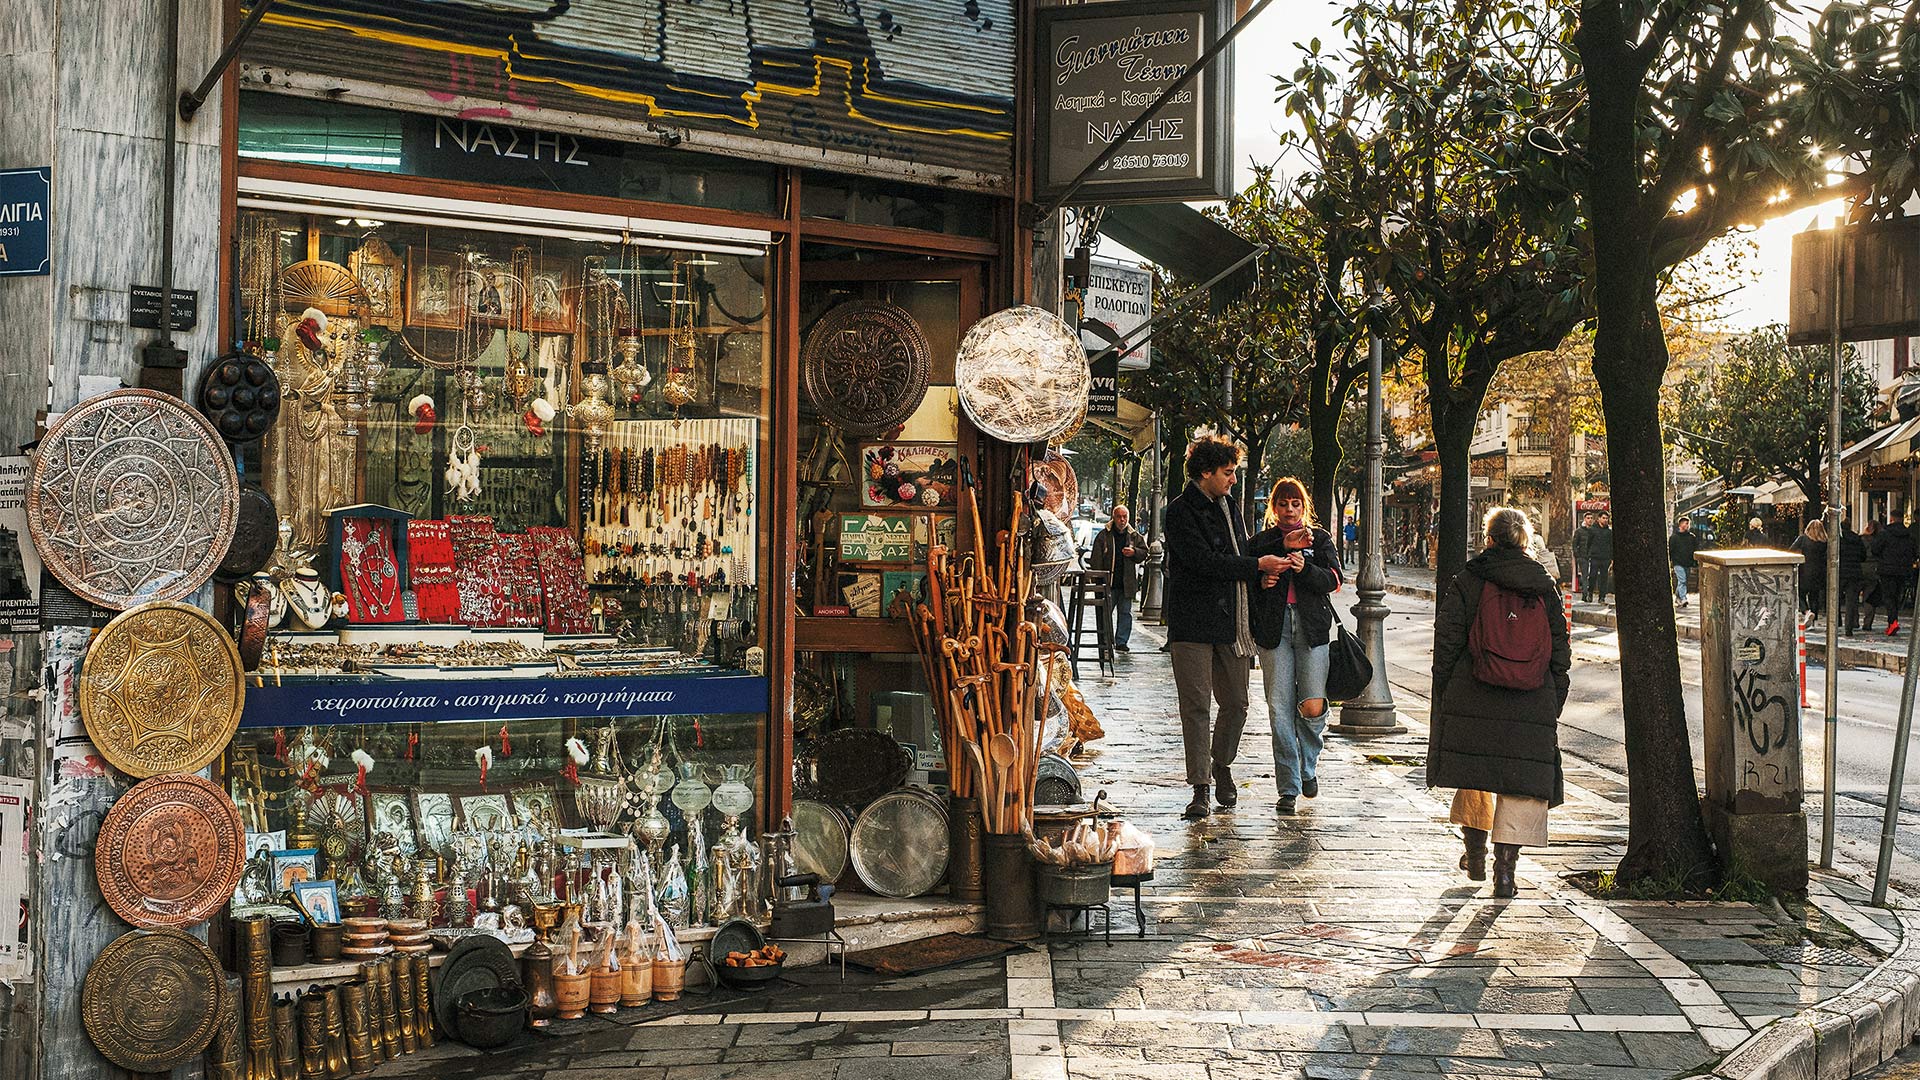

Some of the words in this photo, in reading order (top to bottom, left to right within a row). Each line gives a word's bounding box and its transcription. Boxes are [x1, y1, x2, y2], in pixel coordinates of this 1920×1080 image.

[1117, 54, 1188, 82] Τέχνη
[1055, 90, 1105, 112] Ασημικά
[435, 117, 589, 166] ΝΑΣΗΣ
[1087, 118, 1184, 145] ΝΑΣΗΣ
[1113, 156, 1150, 169] 26510
[1152, 153, 1189, 168] 73019
[1089, 275, 1144, 296] ΕΠΙΣΚΕΥΕΣ
[1094, 295, 1147, 316] ΡΟΛΟΓΙΩΝ
[1090, 377, 1115, 391] χνη
[897, 446, 950, 463] ΚΑΛΗΜΕΡΑ
[845, 520, 908, 532] ΓΑΛΑ
[454, 688, 550, 713] ασημικά
[563, 687, 676, 711] κοσμήματα
